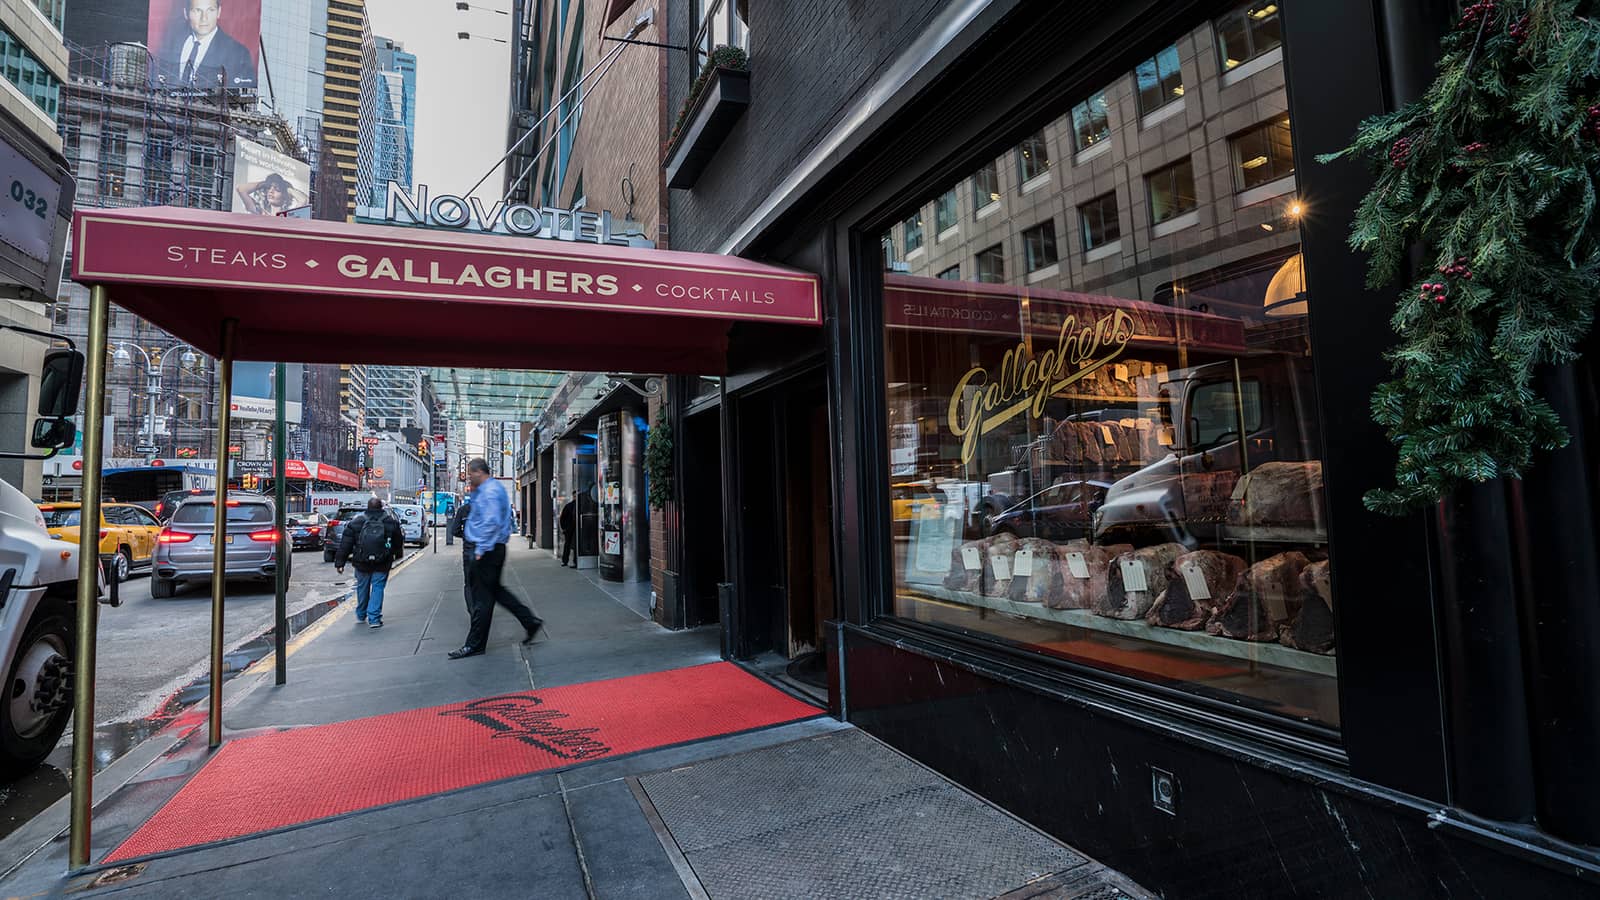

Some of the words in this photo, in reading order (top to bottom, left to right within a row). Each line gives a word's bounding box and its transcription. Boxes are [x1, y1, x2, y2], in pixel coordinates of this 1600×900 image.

[11, 180, 48, 219] 032
[386, 179, 629, 246] NOVOTEL
[167, 246, 287, 269] STEAKS
[337, 254, 619, 296] GALLAGHERS
[655, 282, 776, 305] COCKTAILS
[947, 308, 1136, 465] Gallaghers
[313, 498, 339, 506] GARDA
